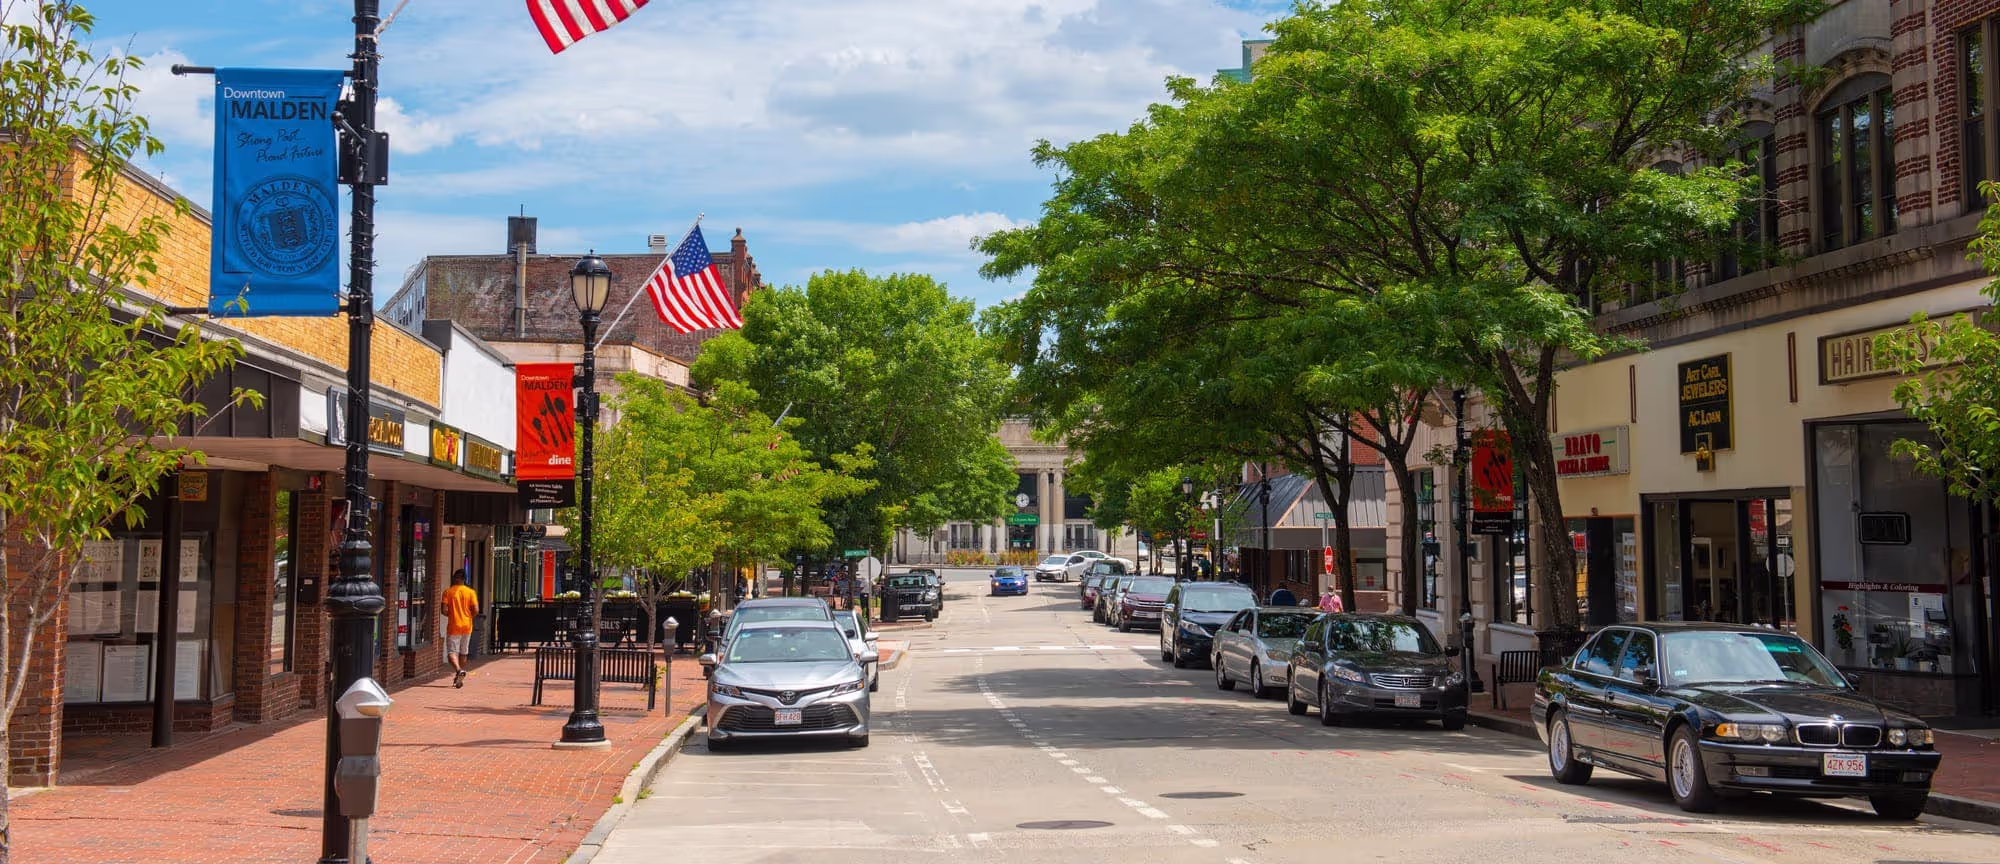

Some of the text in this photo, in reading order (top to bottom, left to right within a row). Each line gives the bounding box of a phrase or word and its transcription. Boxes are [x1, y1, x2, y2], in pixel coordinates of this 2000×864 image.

[224, 87, 285, 99] Downtown
[231, 100, 327, 120] MALDEN
[237, 131, 272, 149] Strong
[256, 146, 324, 163] Proud Future
[248, 181, 313, 206] MALDEN
[524, 380, 568, 390] MALDEN
[1681, 378, 1728, 401] JEWELERS
[1687, 410, 1701, 427] AC
[1564, 433, 1601, 457] BRAVO
[548, 454, 571, 465] dine
[1557, 459, 1580, 475] PIZZA
[1580, 458, 1587, 474] &
[1848, 582, 1881, 591] Highlights
[1890, 584, 1919, 592] Coloring
[1846, 759, 1864, 771] 956
